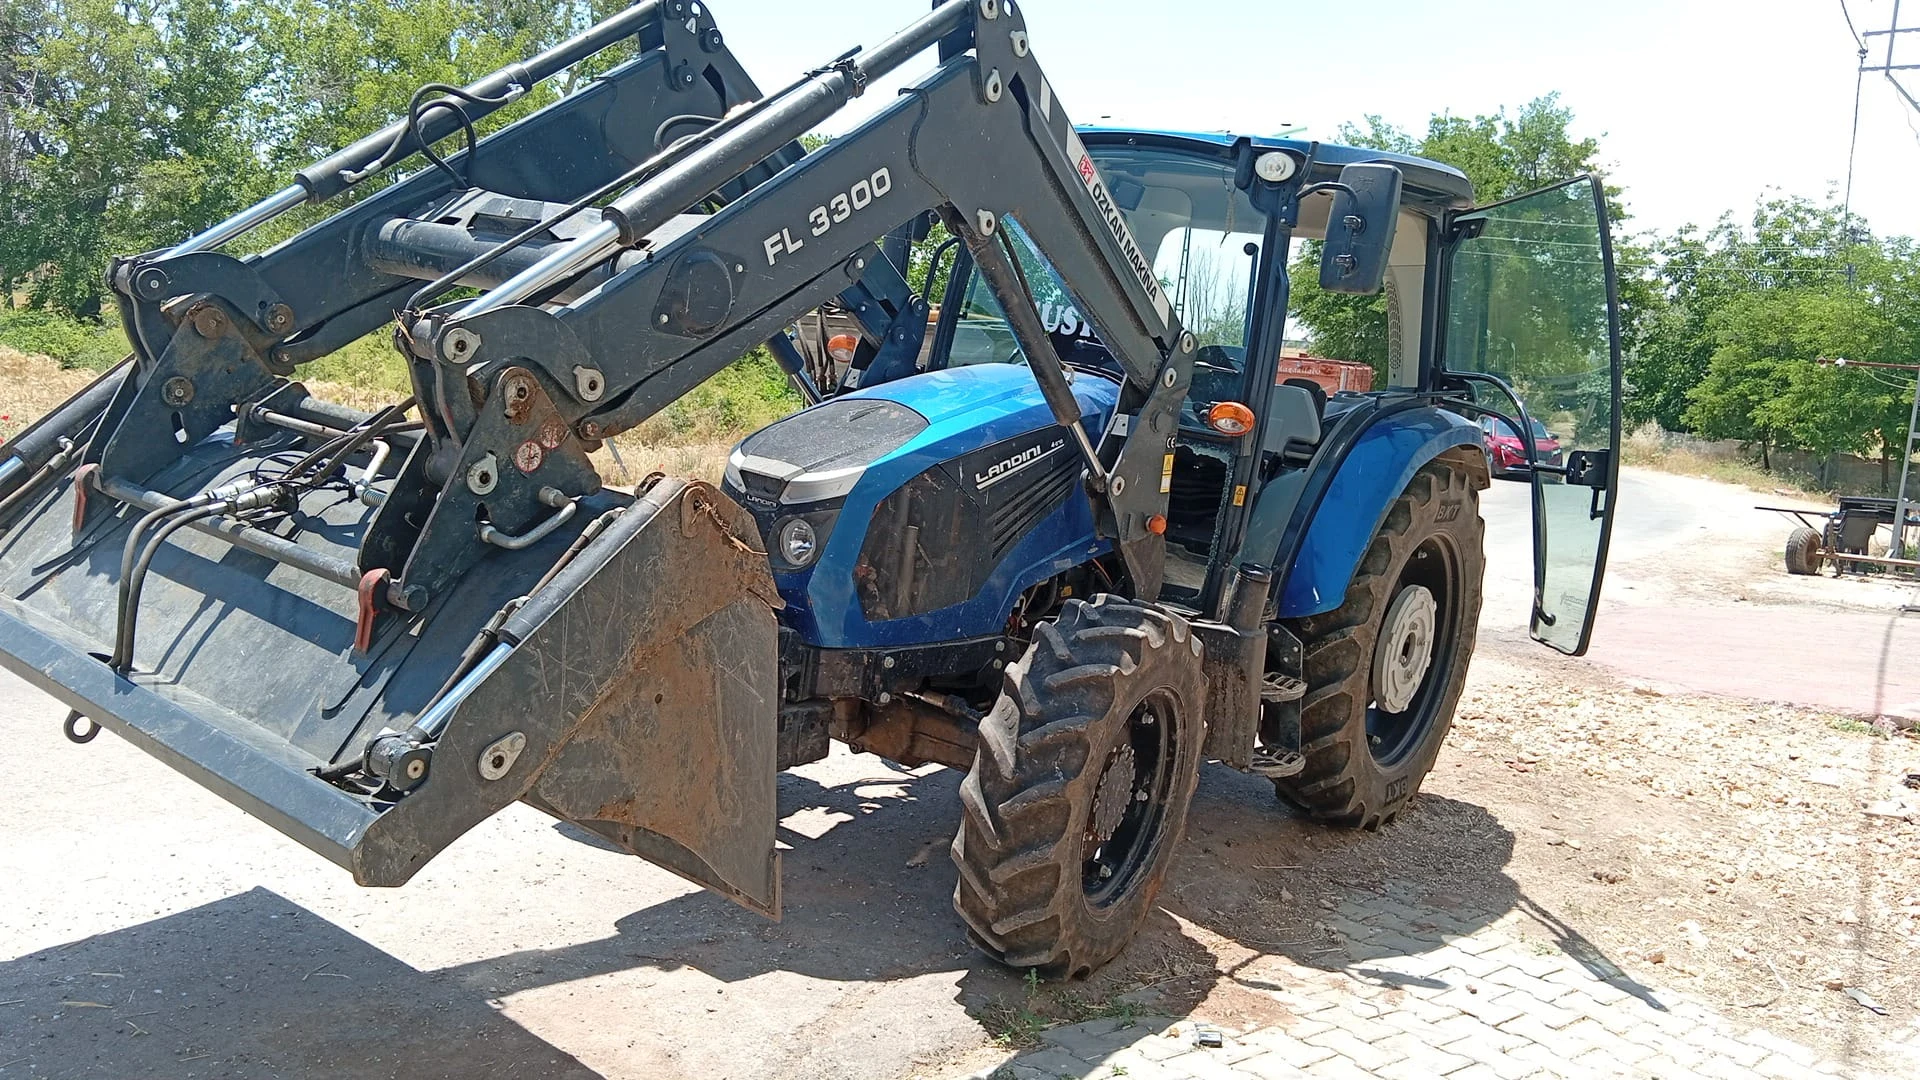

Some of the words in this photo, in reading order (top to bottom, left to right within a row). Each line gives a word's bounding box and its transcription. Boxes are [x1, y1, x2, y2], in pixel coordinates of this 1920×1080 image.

[763, 227, 804, 266] FL
[808, 167, 892, 237] 3300
[1092, 181, 1126, 243] ÖZKAN
[1123, 239, 1158, 302] MAKİNA
[975, 445, 1041, 483] LANDINI
[1436, 503, 1461, 521] BKT
